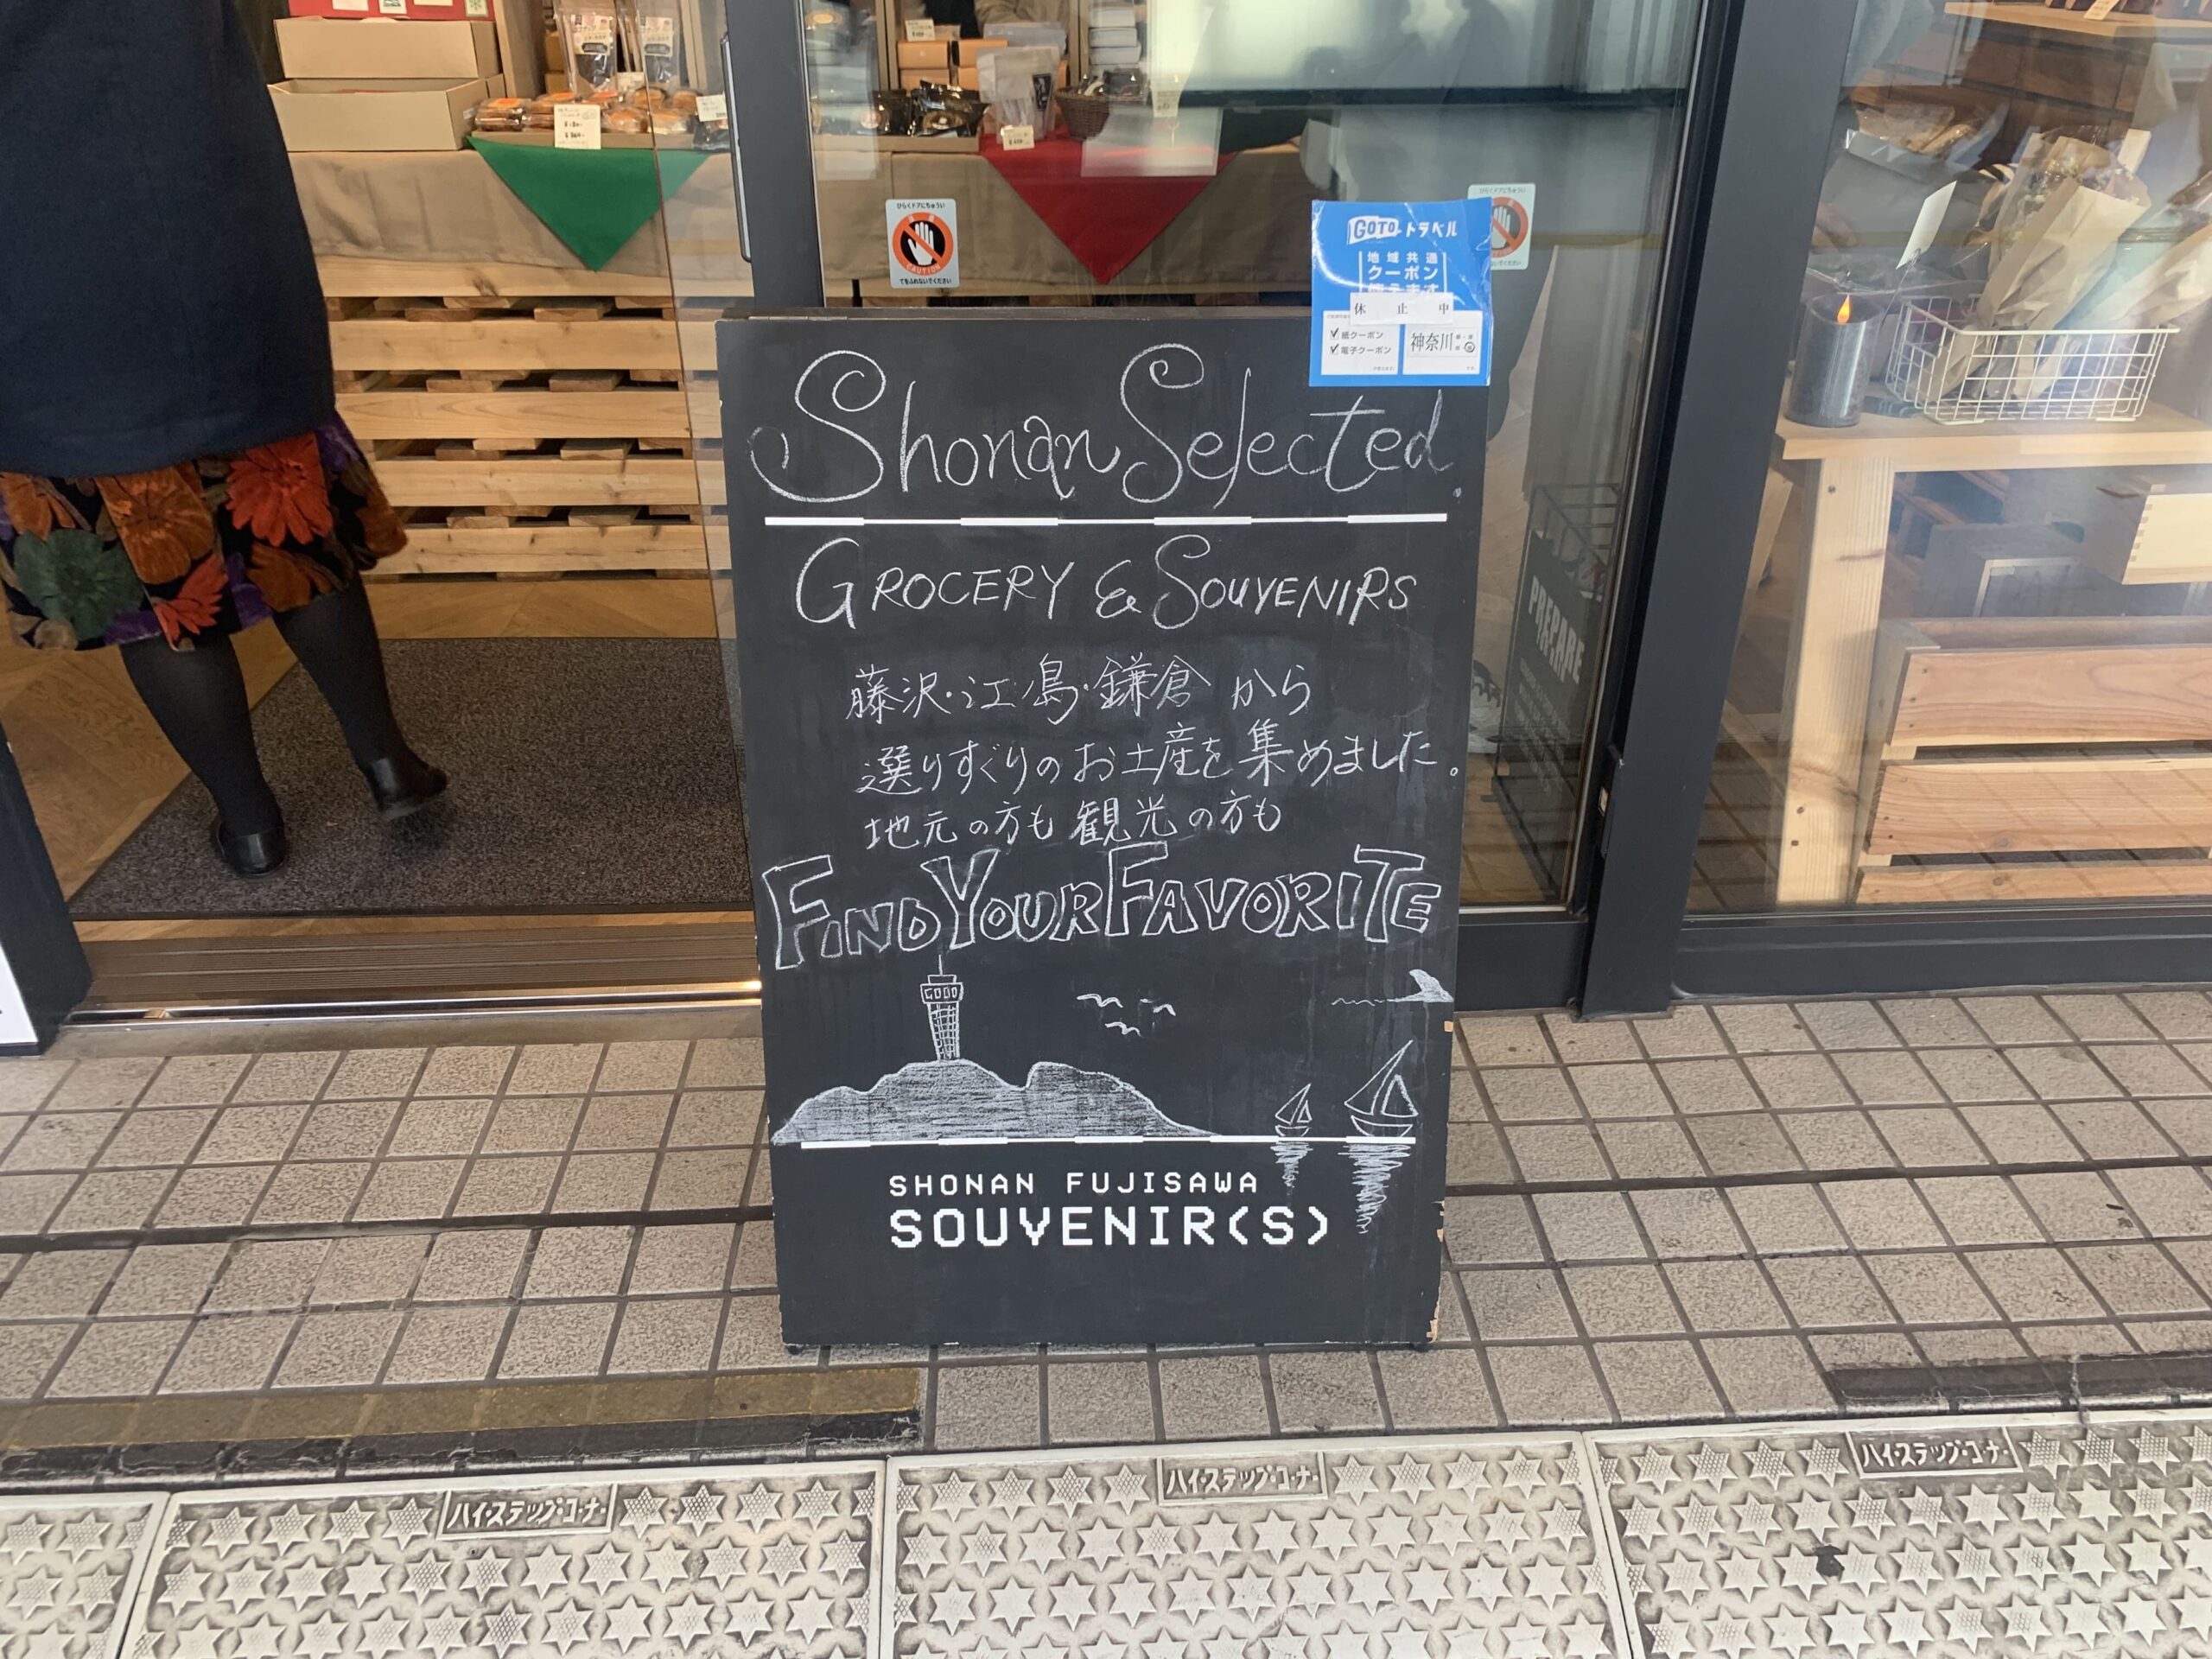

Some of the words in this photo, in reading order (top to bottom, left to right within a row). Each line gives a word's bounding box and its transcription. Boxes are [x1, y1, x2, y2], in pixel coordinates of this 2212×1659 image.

[1405, 220, 1458, 238] トラベル
[1367, 251, 1439, 264] 地域共通
[906, 263, 940, 275] CAUTION
[1368, 265, 1439, 281] クーポン
[1341, 331, 1384, 340] 紙クーポン
[1411, 332, 1453, 353] 神奈川
[1341, 346, 1392, 355] 電子クーポン
[747, 350, 1121, 503] Shonan
[795, 537, 1075, 630] GROCERY
[1096, 560, 1143, 620] &
[761, 854, 942, 970] FIND
[919, 848, 1103, 950] YOUR
[1104, 840, 1442, 944] FAVORITE
[889, 1172, 1034, 1197] SHONAN
[1066, 1171, 1258, 1194] FUJISAWA
[889, 1205, 1329, 1249] SOUVENIR(S)
